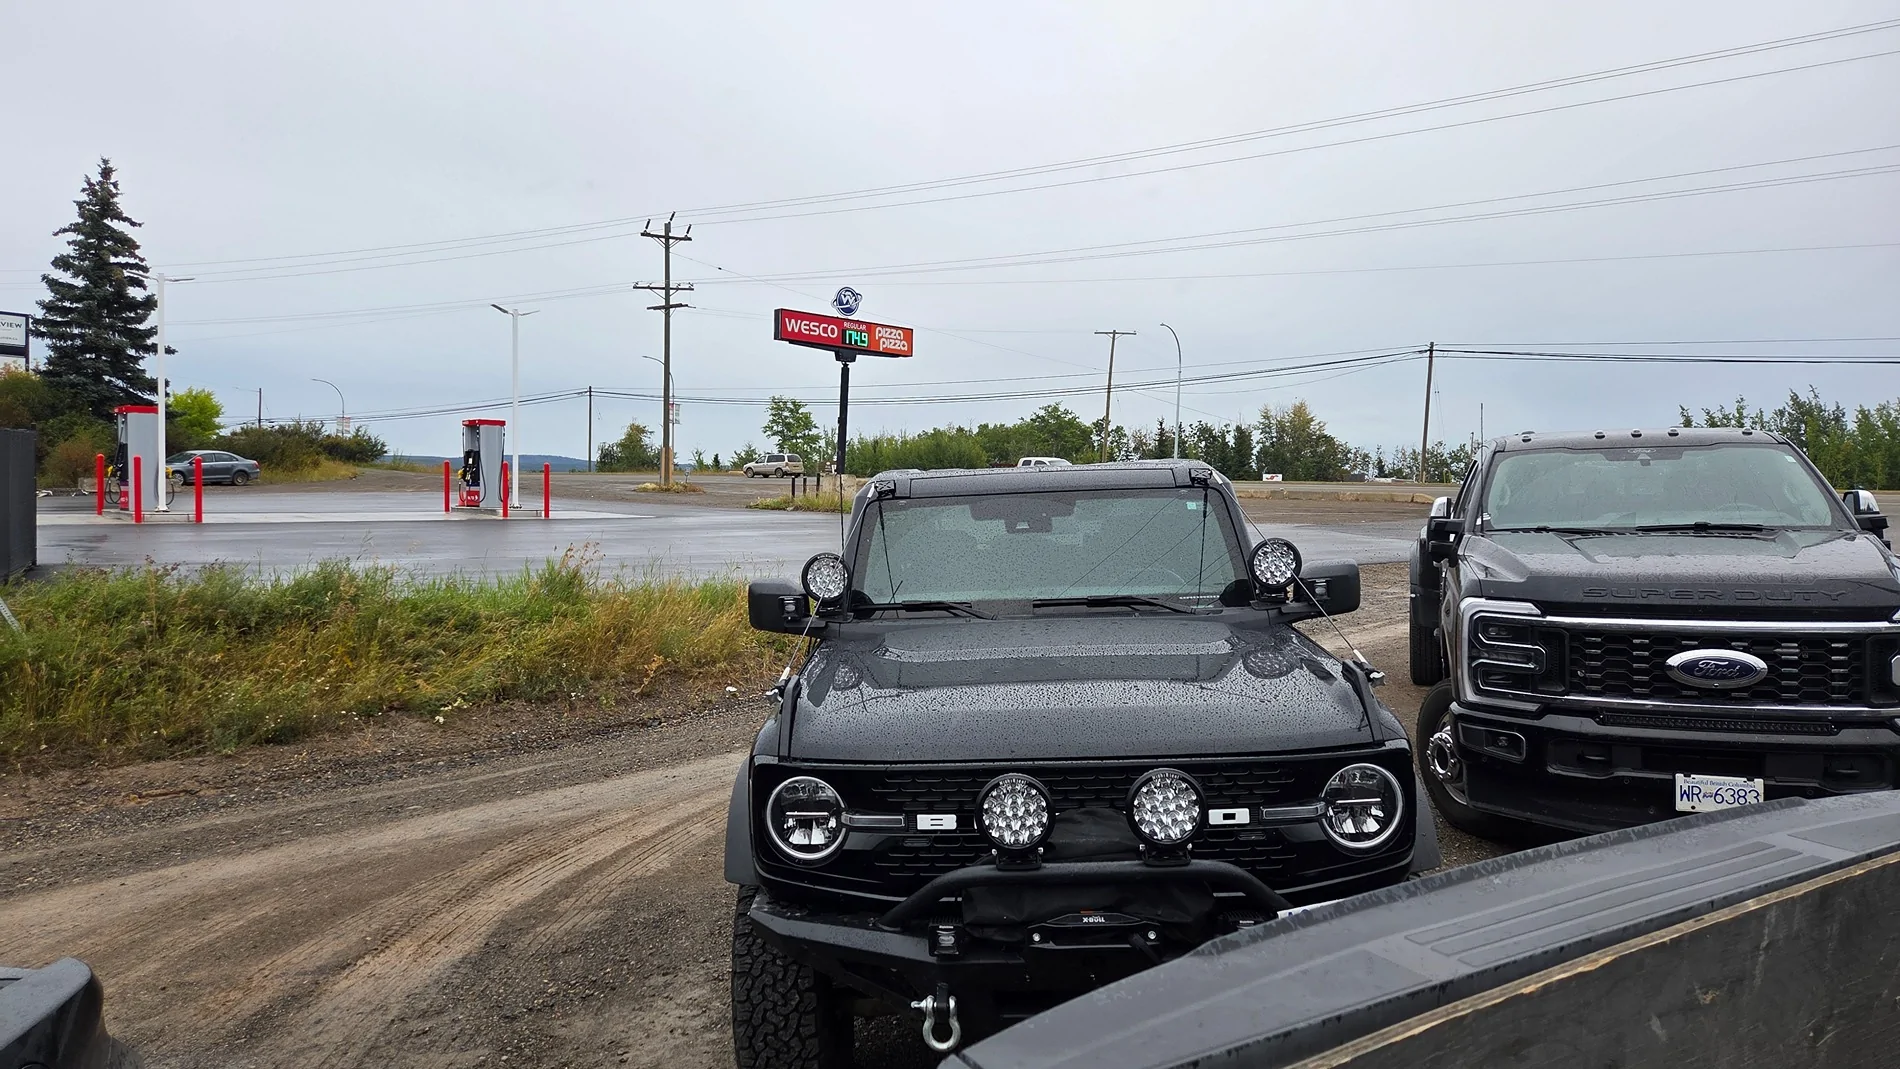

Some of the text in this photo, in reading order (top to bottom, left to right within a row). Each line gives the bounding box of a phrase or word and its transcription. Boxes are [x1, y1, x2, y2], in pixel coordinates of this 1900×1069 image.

[785, 318, 838, 337] WESCO
[843, 321, 866, 330] REGULAR
[875, 326, 903, 340] pizza
[879, 337, 907, 351] pizza
[1582, 587, 1848, 603] SUPER DUTY
[1693, 659, 1741, 680] Ford
[1680, 785, 1760, 805] WR 6383
